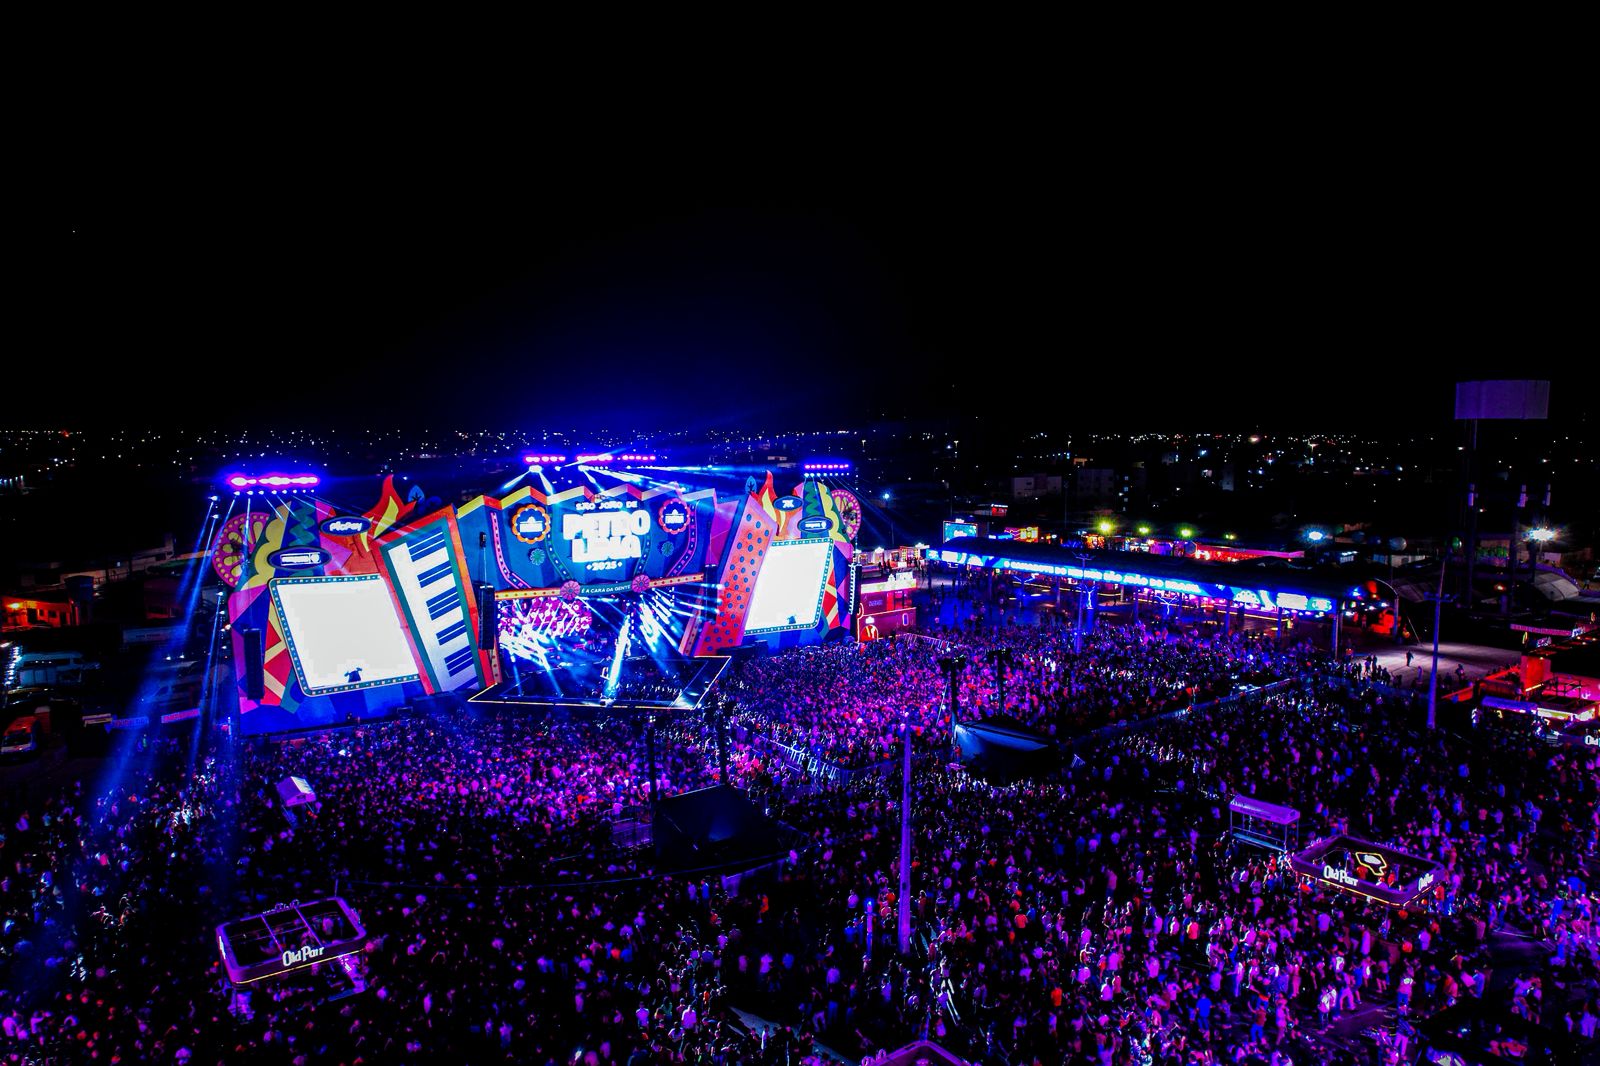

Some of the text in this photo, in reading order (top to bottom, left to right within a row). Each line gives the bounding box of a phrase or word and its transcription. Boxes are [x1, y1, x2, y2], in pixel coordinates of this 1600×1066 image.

[599, 500, 623, 509] JOÃO
[591, 561, 617, 570] 2025
[1323, 865, 1358, 885] Old Parr
[283, 946, 324, 965] Old Parr
